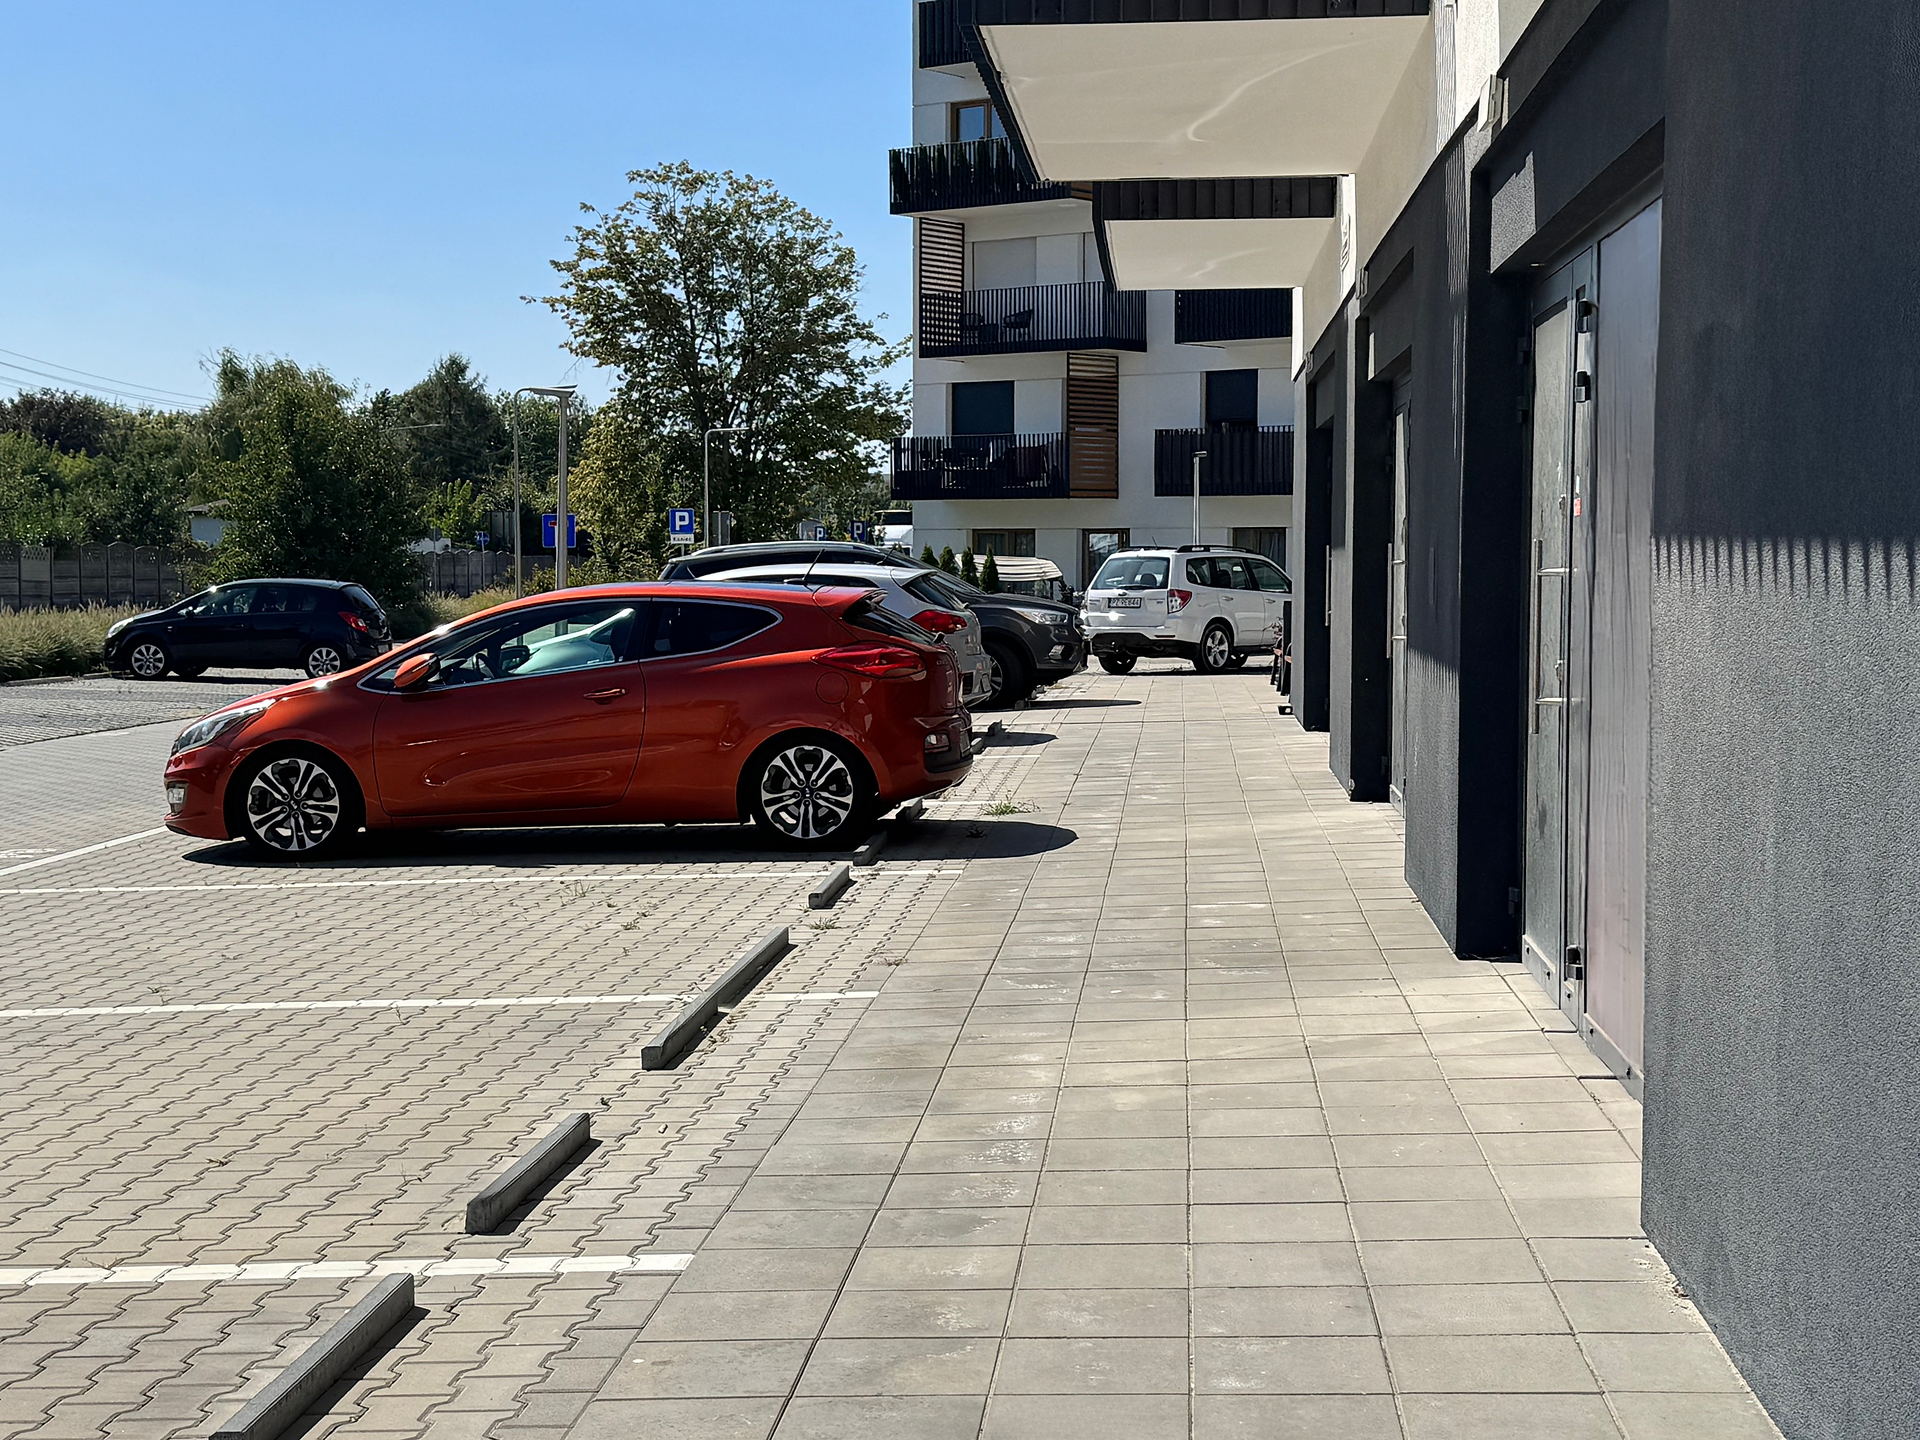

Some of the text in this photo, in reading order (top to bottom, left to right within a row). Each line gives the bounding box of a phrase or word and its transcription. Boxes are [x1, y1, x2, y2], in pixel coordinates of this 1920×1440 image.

[675, 511, 690, 531] P
[816, 527, 825, 541] P
[853, 522, 863, 538] P
